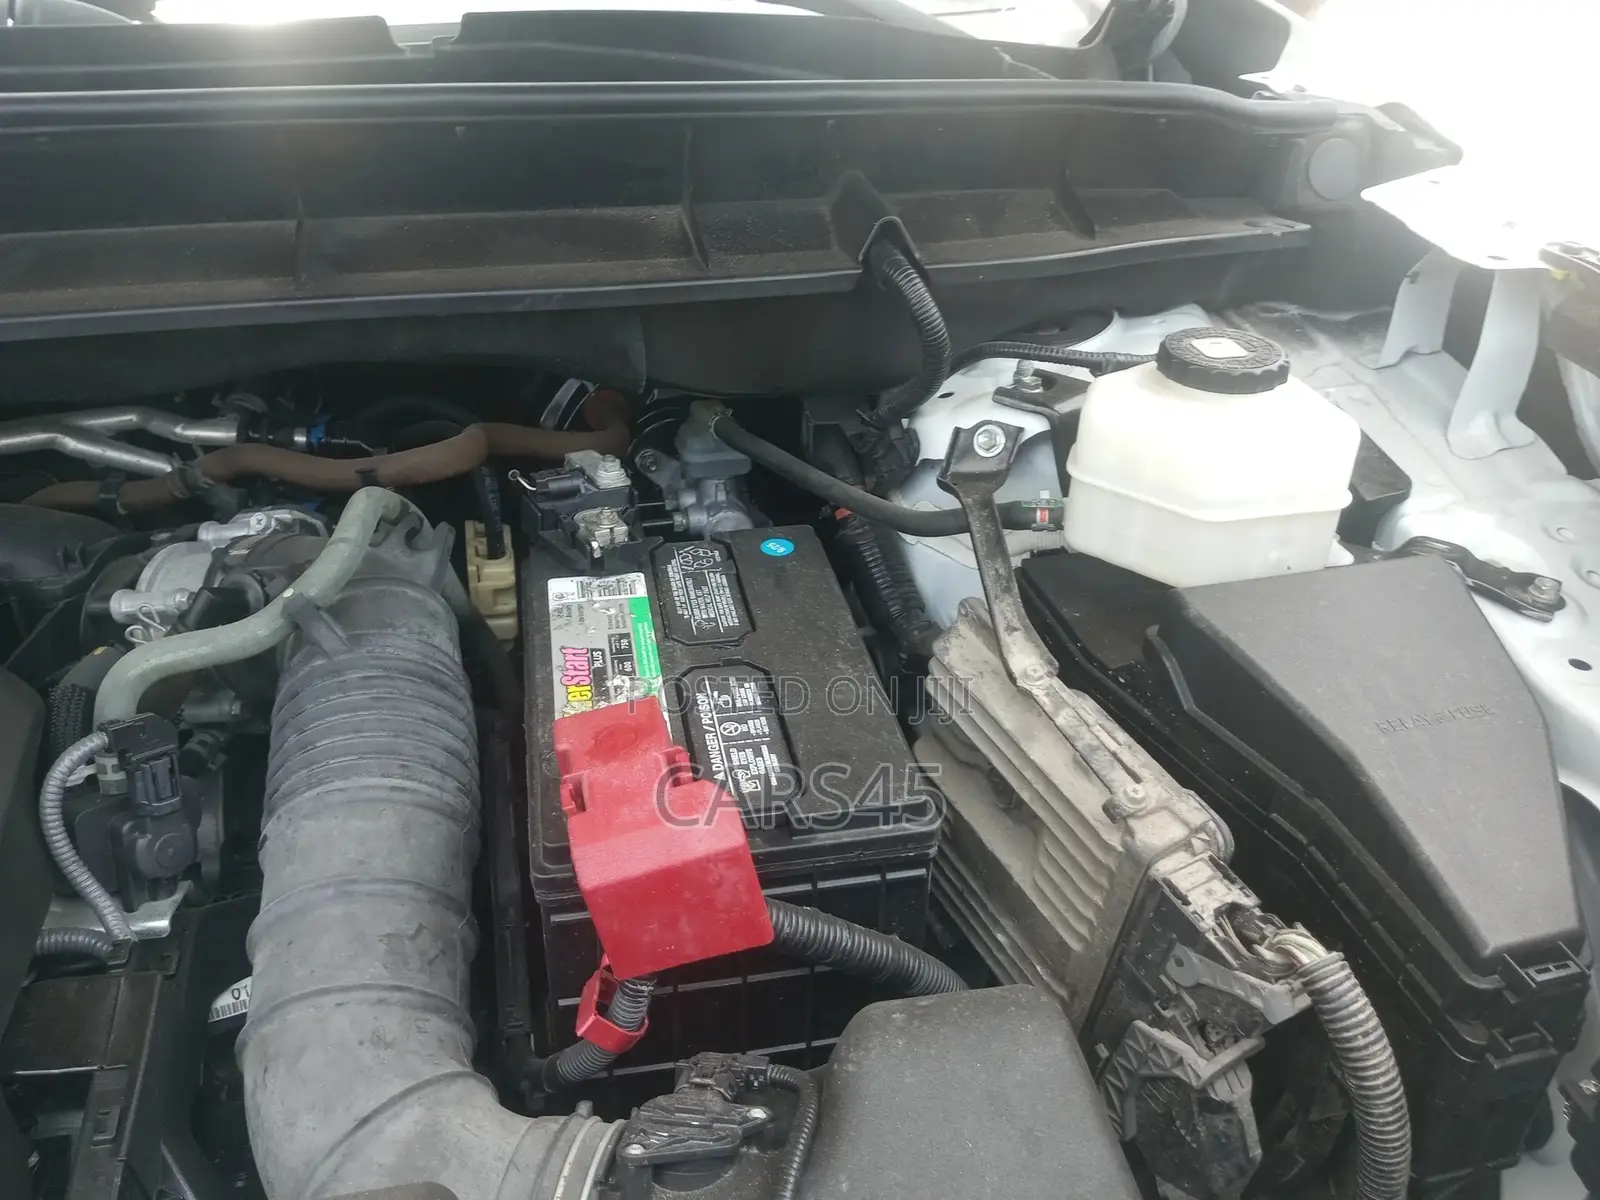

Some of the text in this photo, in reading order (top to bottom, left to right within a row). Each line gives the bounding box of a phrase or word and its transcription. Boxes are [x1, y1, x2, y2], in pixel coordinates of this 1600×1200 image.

[620, 638, 629, 649] 750
[592, 650, 603, 668] PLUS
[623, 661, 632, 672] 600
[696, 692, 714, 724] POISON
[1375, 712, 1432, 733] RELAY
[1446, 703, 1496, 720] FUSE
[705, 733, 725, 771] DANGER
